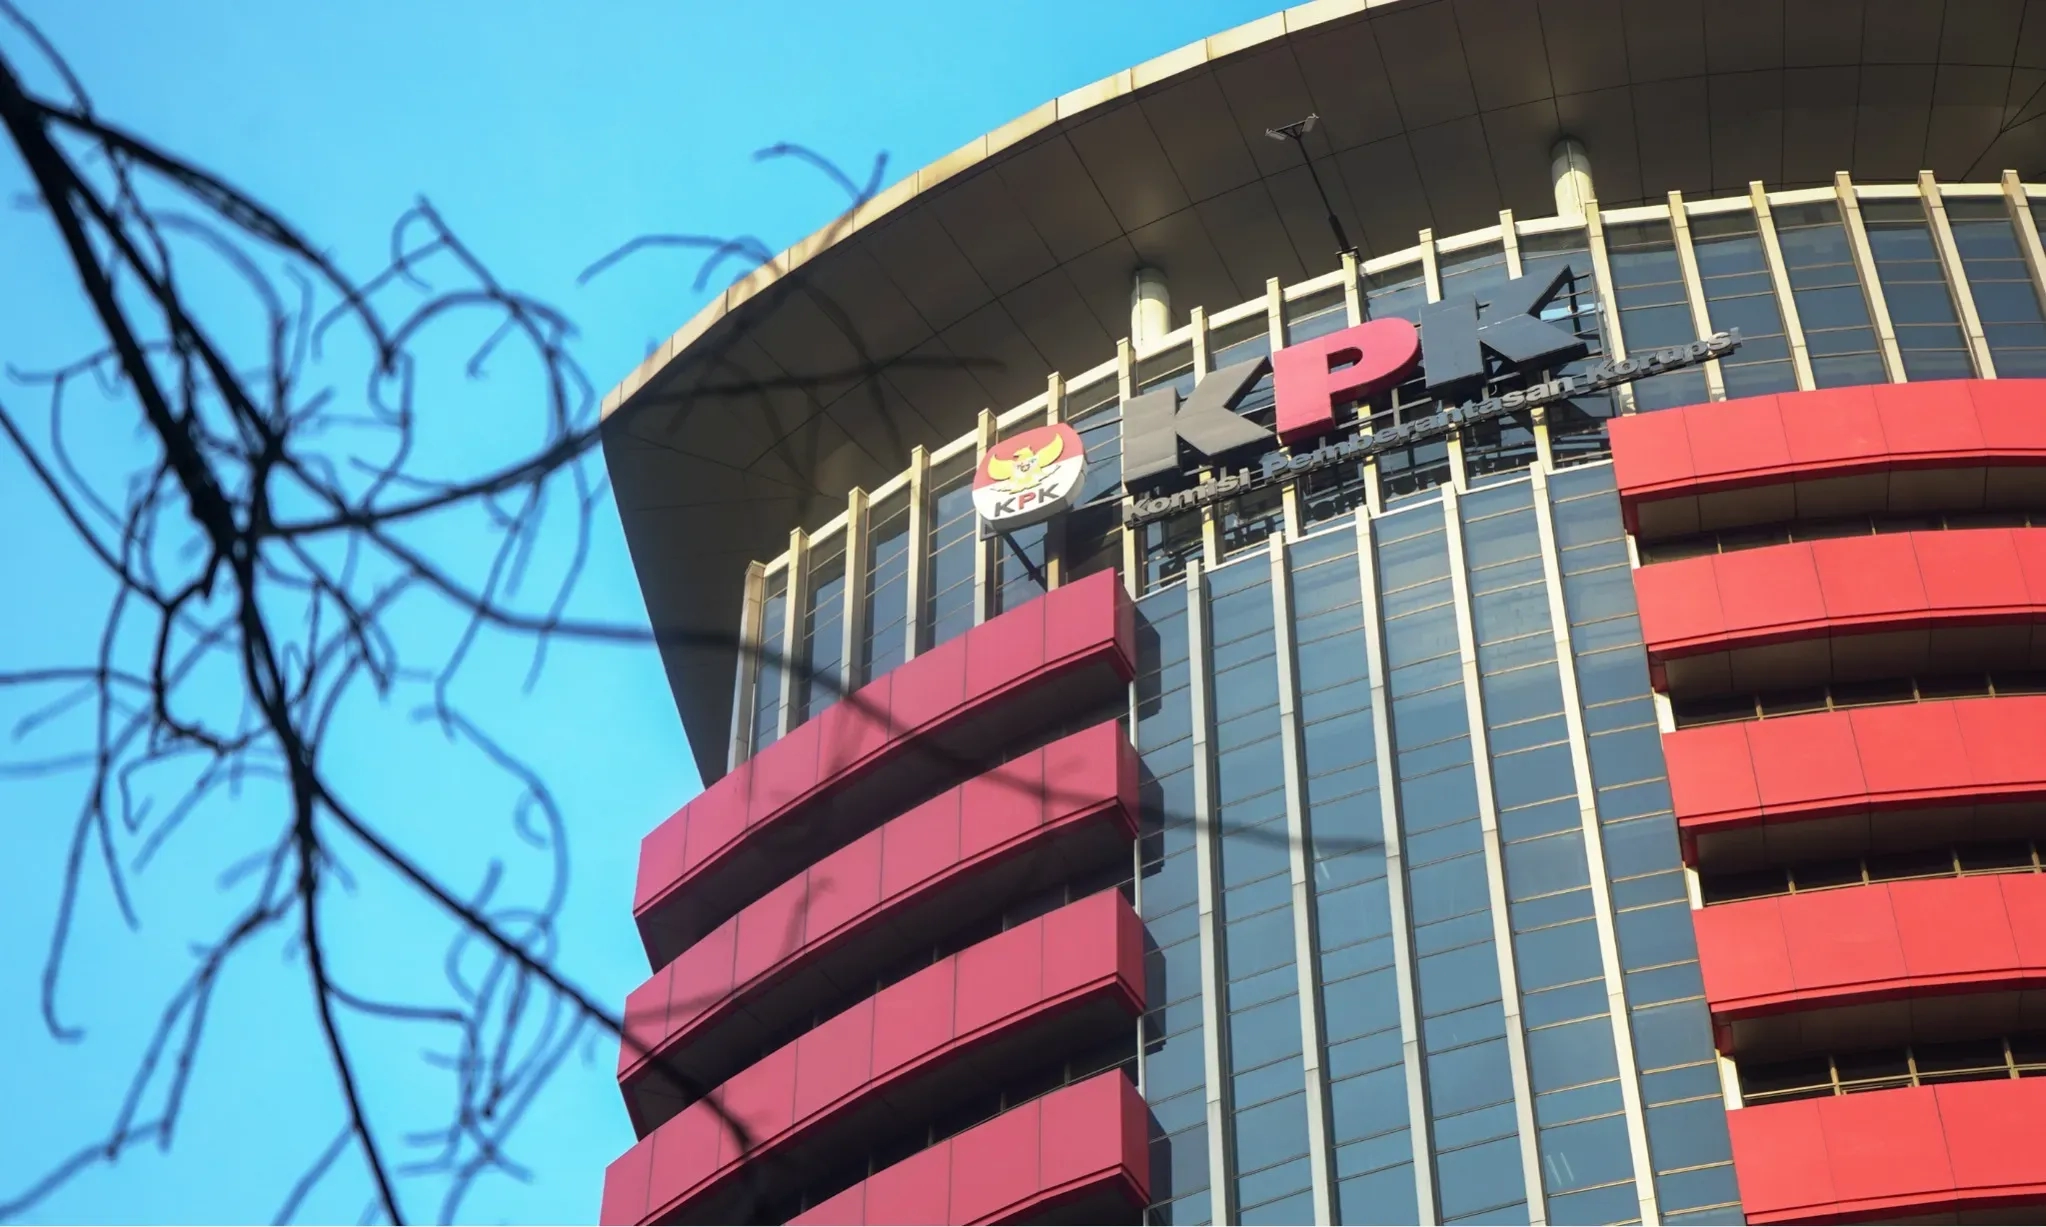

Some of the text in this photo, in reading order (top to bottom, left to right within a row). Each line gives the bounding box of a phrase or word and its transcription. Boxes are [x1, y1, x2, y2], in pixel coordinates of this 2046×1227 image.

[1122, 264, 1590, 490] KPK
[1124, 326, 1742, 524] Komisi Pemberantasan Korupsi
[993, 481, 1061, 518] KPK
